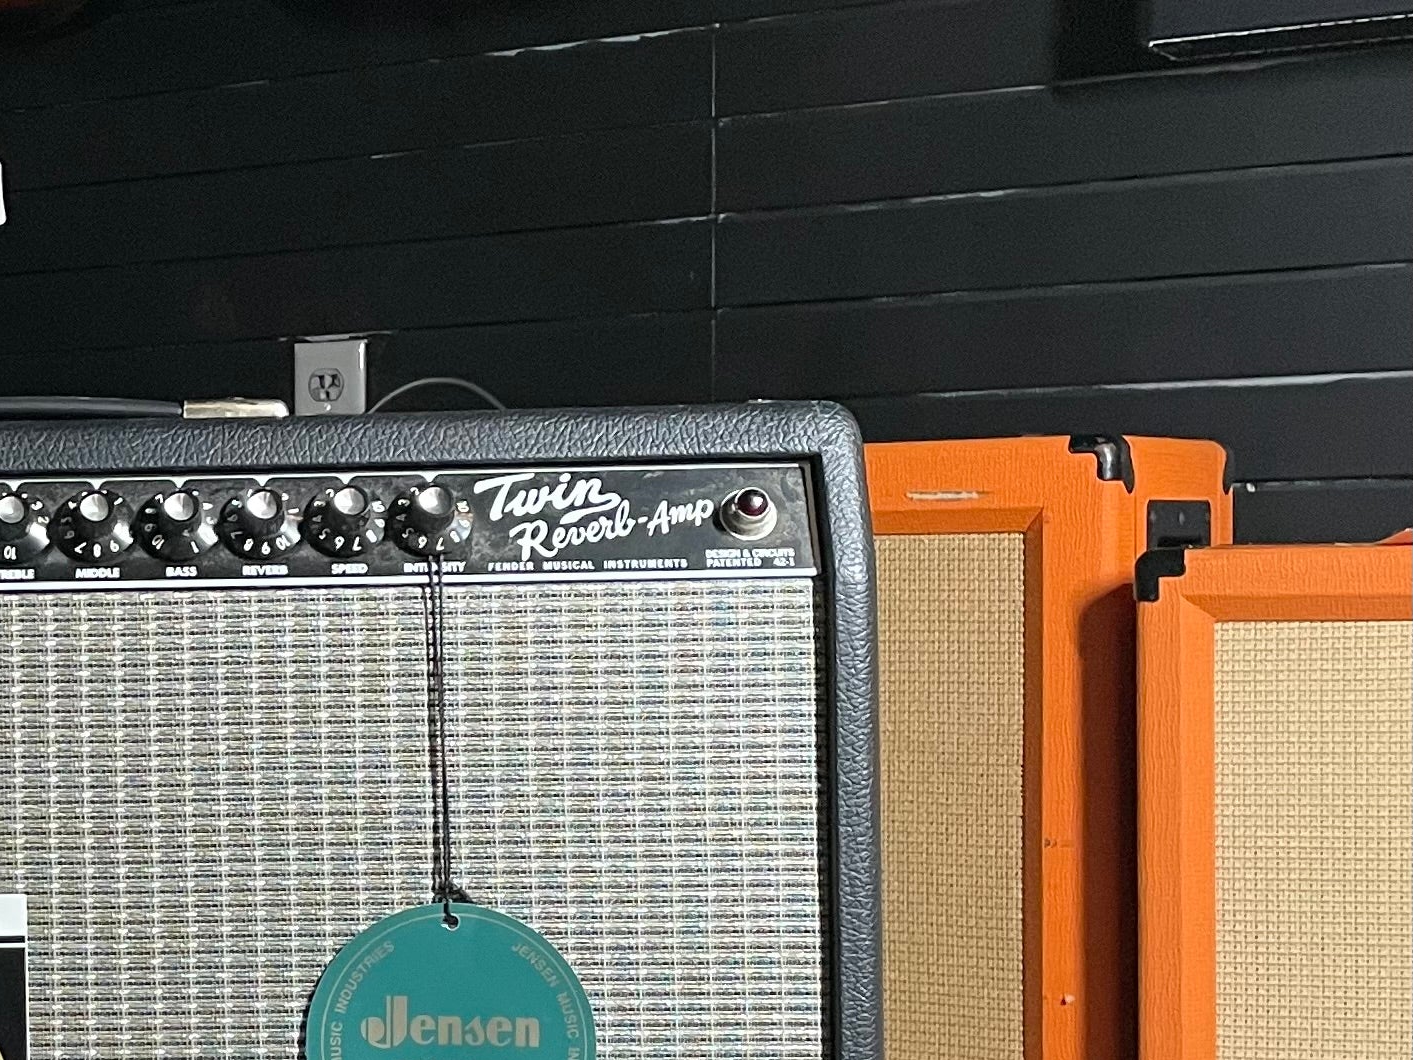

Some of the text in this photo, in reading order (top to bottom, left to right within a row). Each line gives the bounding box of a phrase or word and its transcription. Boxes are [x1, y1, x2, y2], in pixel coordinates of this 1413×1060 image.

[473, 472, 622, 525] Twin
[509, 499, 715, 561] Reverb-Amp
[705, 547, 796, 558] DESIGN & CIRCUITS
[331, 563, 368, 574] SPEED
[488, 558, 688, 571] FENDER MUSICAL INSTRUMENTS
[706, 557, 763, 568] PATENTED
[75, 567, 120, 578] MIDDLE
[165, 566, 197, 577] BASS
[242, 564, 288, 575] REVERB
[334, 941, 395, 1014] INDUSTRIES
[510, 943, 561, 988] JENSEN
[555, 991, 580, 1039] MUSIC
[360, 995, 540, 1049] Jensen
